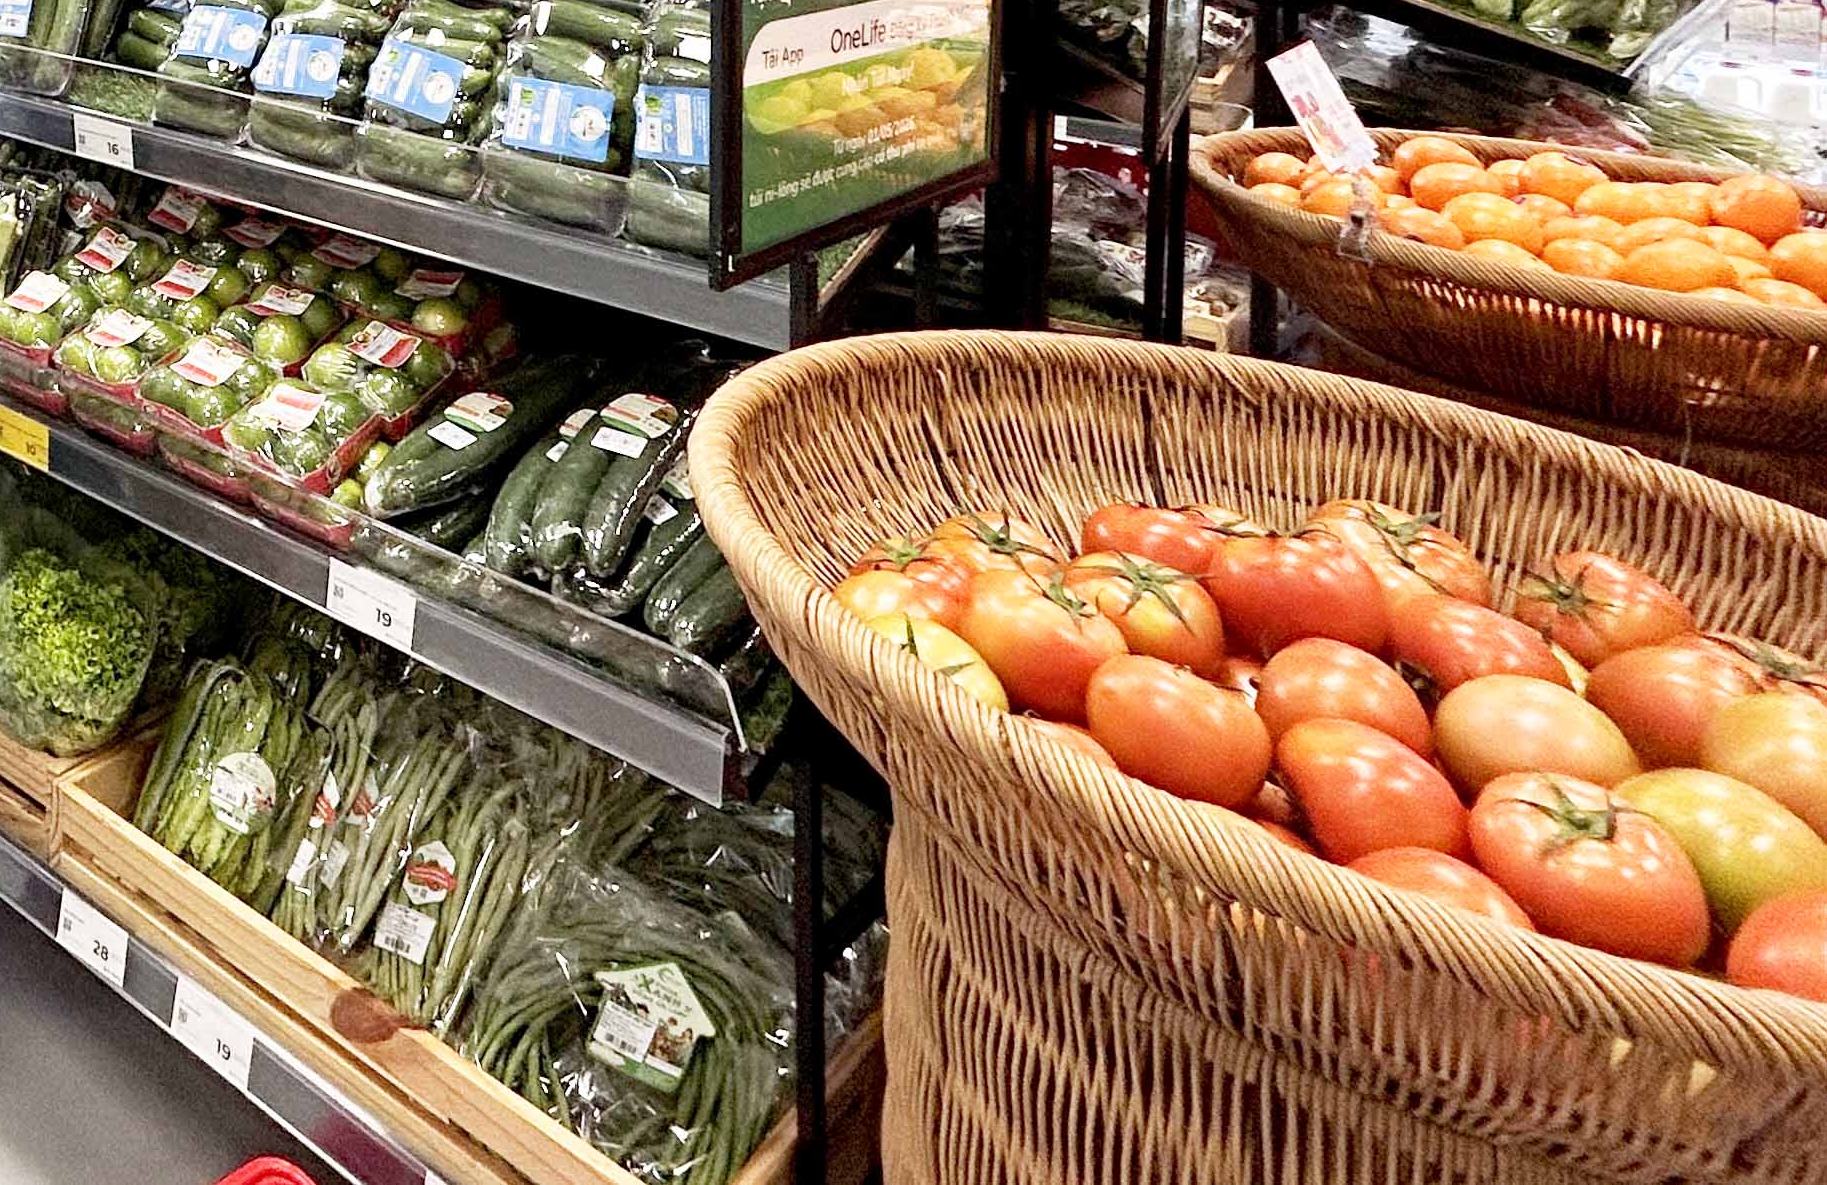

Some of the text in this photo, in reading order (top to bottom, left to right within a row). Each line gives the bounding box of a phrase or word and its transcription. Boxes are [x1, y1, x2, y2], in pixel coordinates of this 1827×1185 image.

[830, 15, 887, 54] OneLife
[107, 142, 120, 155] 16
[376, 607, 392, 627] 19
[92, 939, 109, 961] 28
[216, 1038, 231, 1061] 19
